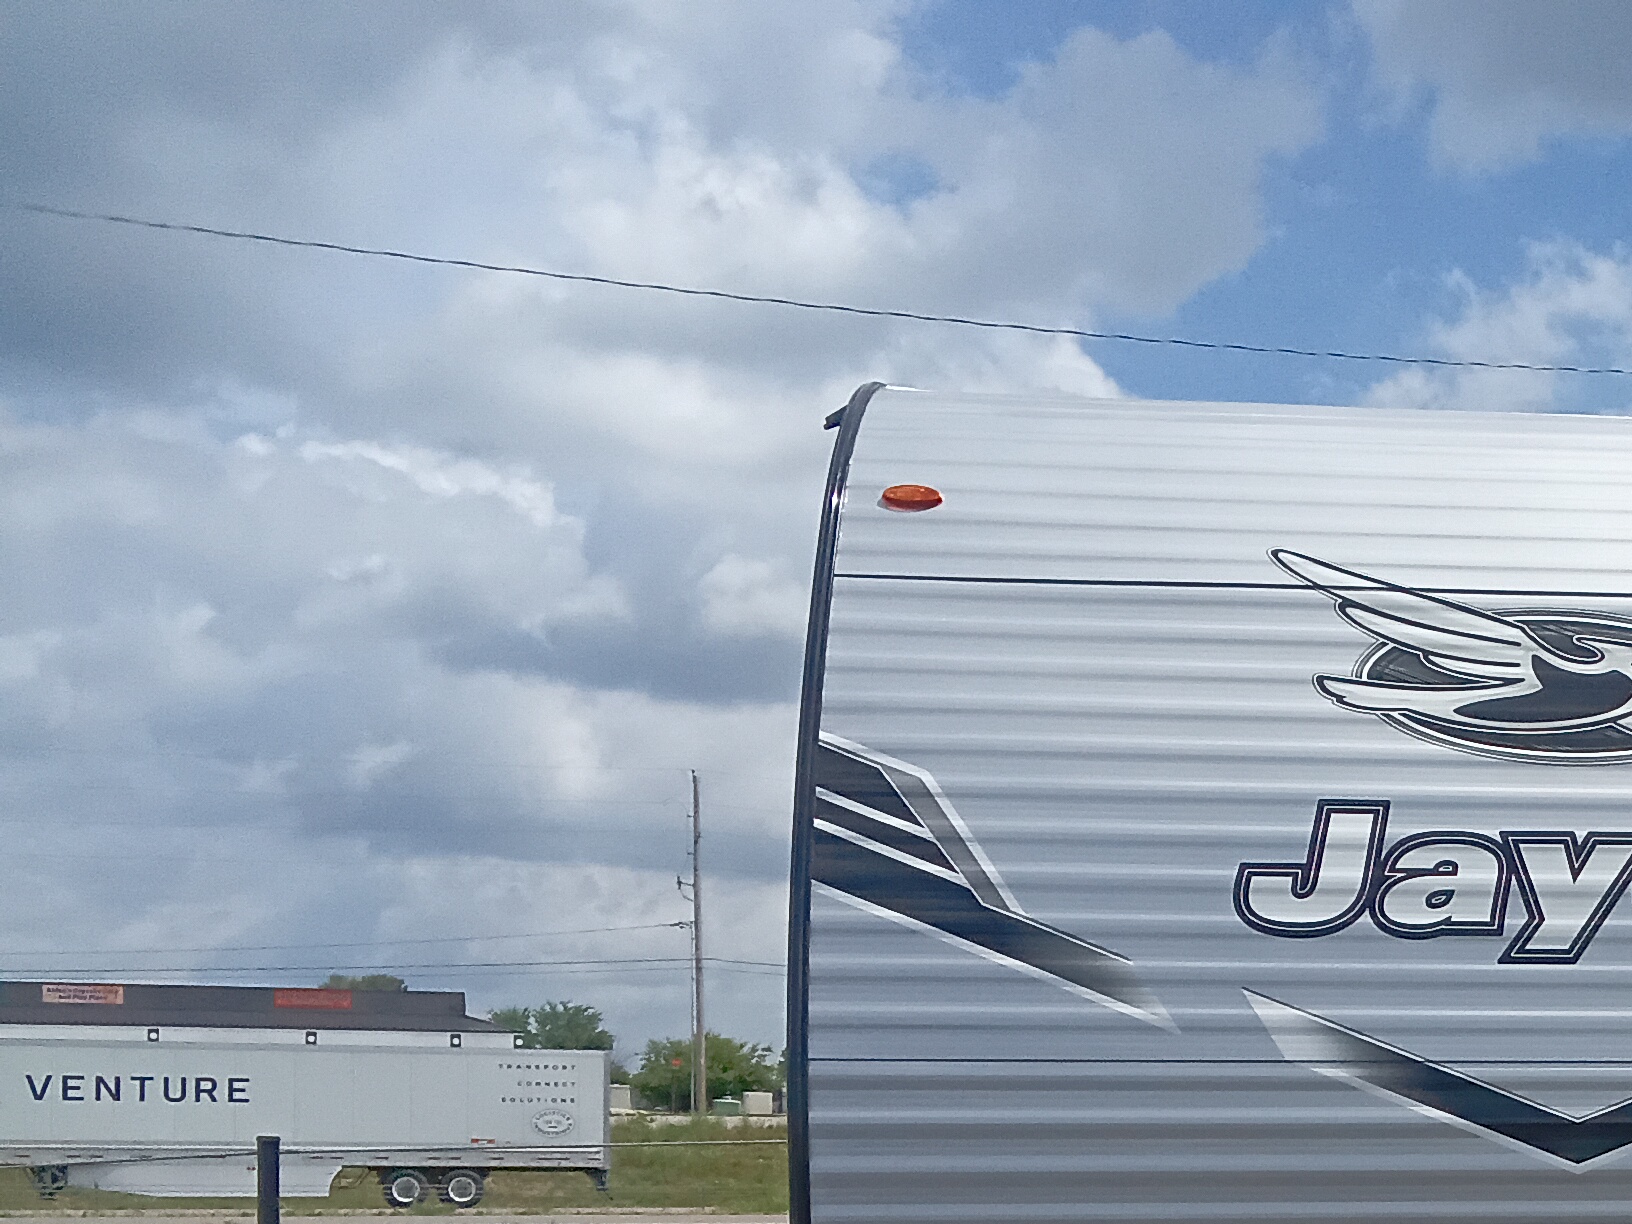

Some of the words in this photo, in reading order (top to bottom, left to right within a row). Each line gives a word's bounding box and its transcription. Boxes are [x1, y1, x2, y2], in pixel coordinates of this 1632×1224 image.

[498, 1063, 576, 1071] TRANSPORT
[25, 1074, 251, 1103] VENTURE
[501, 1096, 575, 1104] SOLUTIONS
